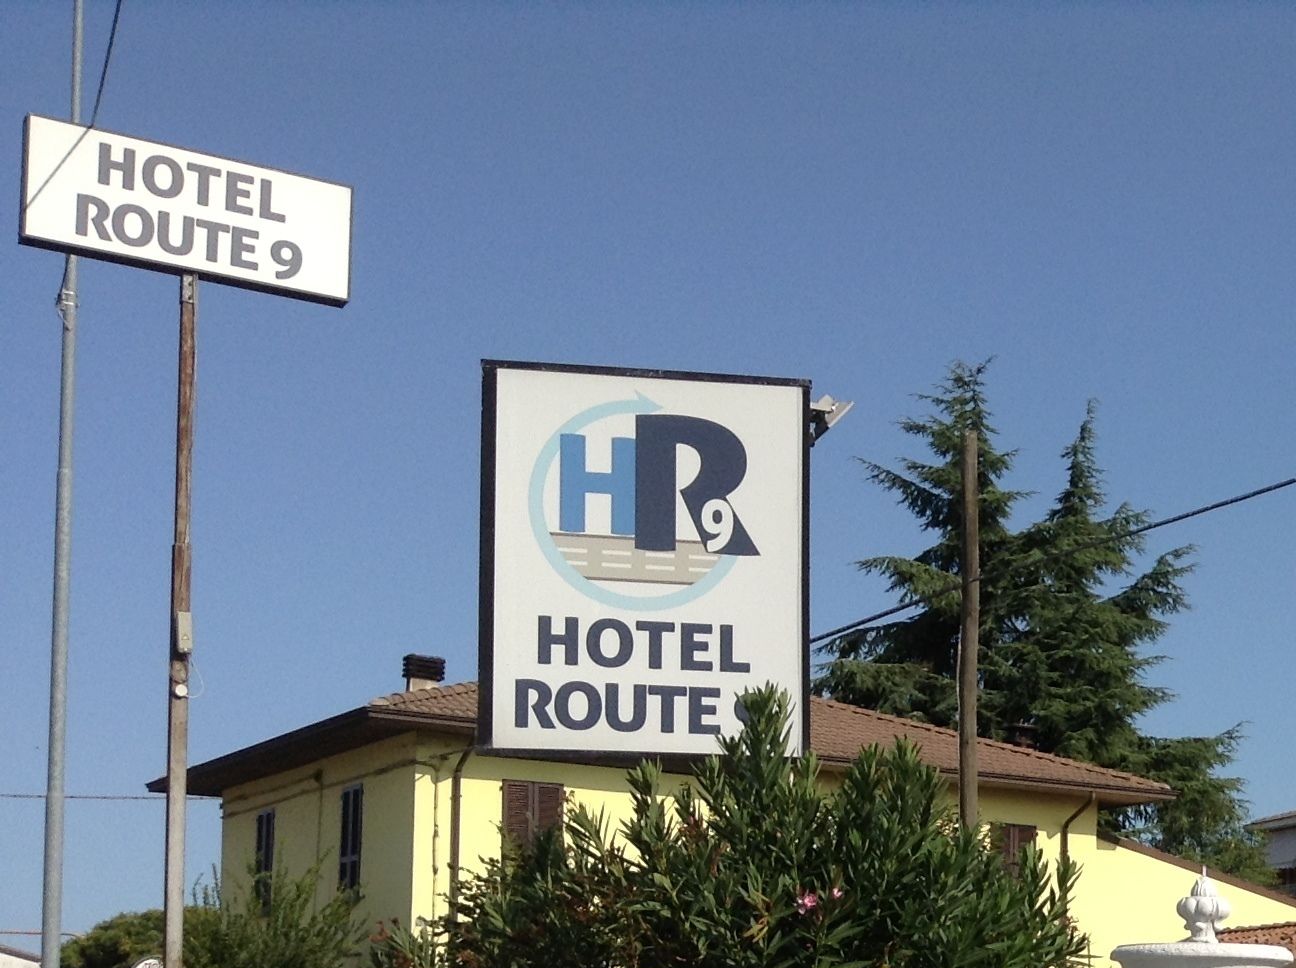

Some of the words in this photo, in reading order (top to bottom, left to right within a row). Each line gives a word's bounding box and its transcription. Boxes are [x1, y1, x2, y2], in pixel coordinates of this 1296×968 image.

[98, 142, 286, 223] HOTEL
[75, 193, 260, 271] ROUTE
[270, 240, 303, 280] 9
[537, 615, 751, 673] HOTEL
[514, 678, 721, 735] ROUTE
